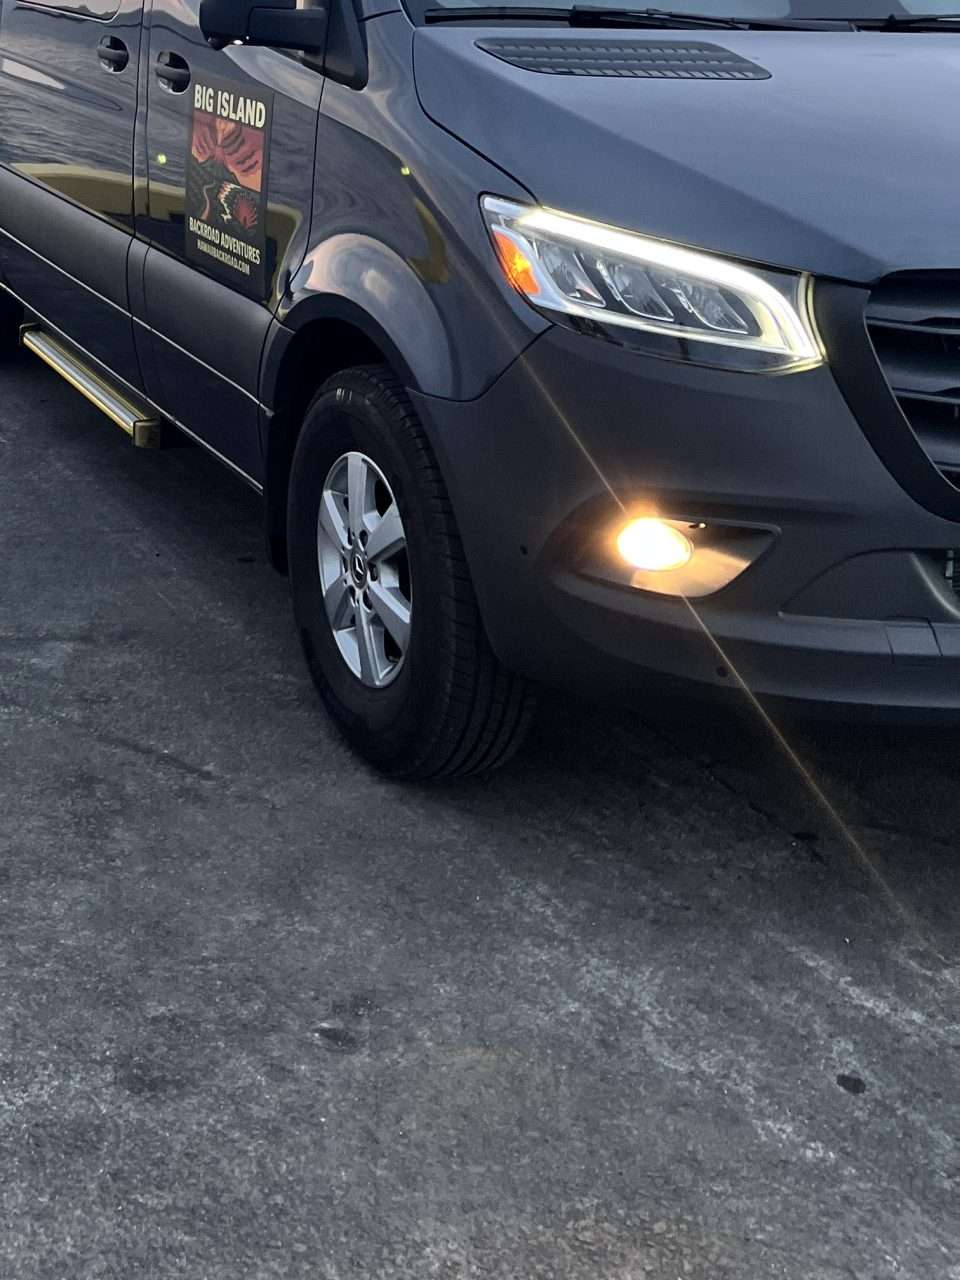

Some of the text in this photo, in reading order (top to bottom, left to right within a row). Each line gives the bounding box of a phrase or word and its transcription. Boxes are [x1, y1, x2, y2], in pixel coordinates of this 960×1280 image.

[194, 84, 266, 128] BIG ISLAND
[189, 216, 261, 265] BACKROAD ADVENTURES
